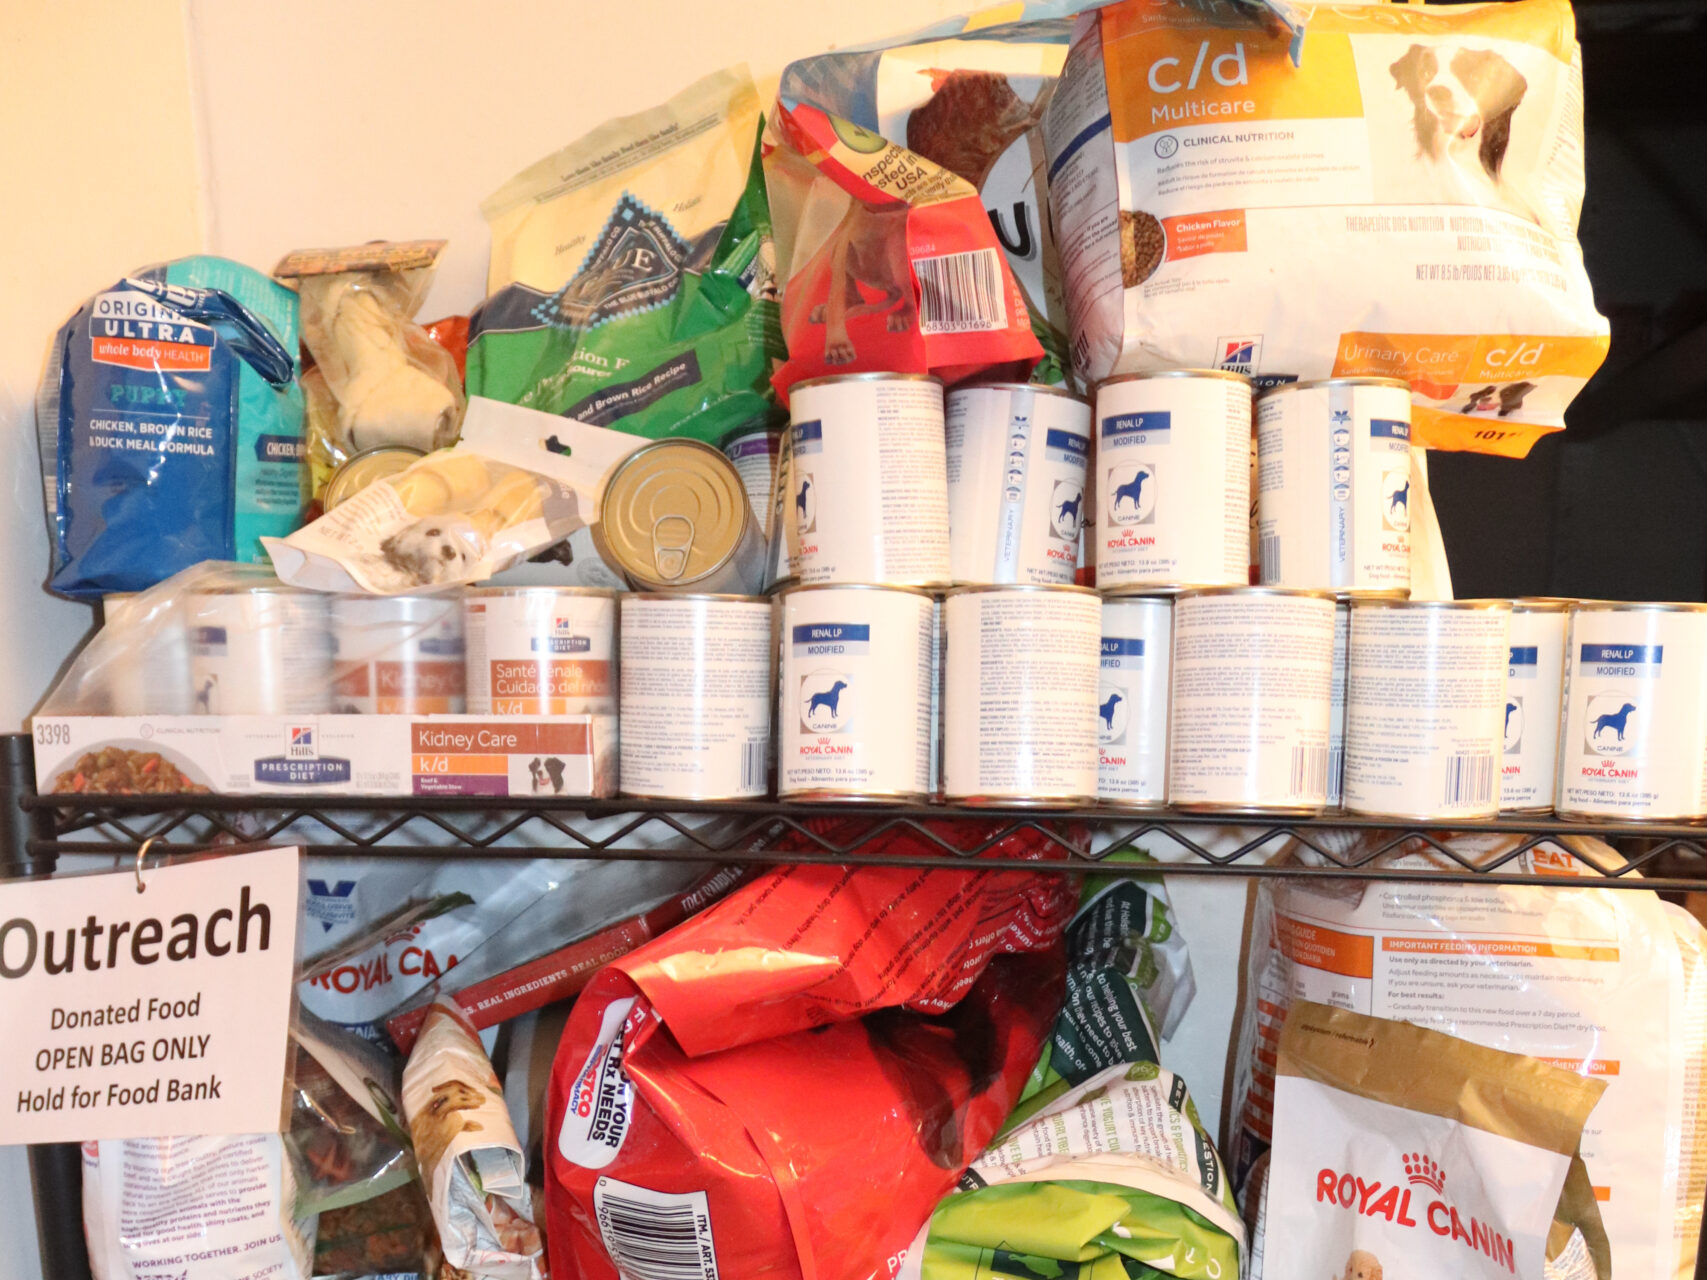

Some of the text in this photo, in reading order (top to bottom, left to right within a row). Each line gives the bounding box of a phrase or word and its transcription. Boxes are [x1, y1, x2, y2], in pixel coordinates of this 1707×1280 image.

[1147, 41, 1249, 94] c/d
[1151, 98, 1256, 125] Multicare
[1183, 132, 1294, 148] CLINICAL NUTRITION
[895, 165, 928, 190] USA
[1176, 217, 1240, 233] Chicken Flavor
[1345, 216, 1391, 232] THERAPEUTIC
[1408, 216, 1445, 232] NUTRITION
[103, 320, 195, 344] ULTRA
[98, 342, 204, 362] whole body HEALTH
[1344, 342, 1545, 366] Urinary Care c/d
[110, 383, 188, 407] PUPPY
[577, 403, 593, 422] and
[595, 390, 629, 411] Brown
[631, 381, 653, 399] Rice
[653, 360, 687, 389] Recipe
[89, 419, 213, 439] CHICKEN, BROWN RICE
[1116, 418, 1144, 429] RENAL LP
[1113, 434, 1146, 446] MODIFIED
[1117, 514, 1140, 522] CANINE
[1003, 508, 1016, 562] VETERINARY
[1107, 536, 1155, 549] ROYAL CANIN
[811, 628, 842, 638] RENAL LP
[807, 645, 845, 655] MODIFIED
[1601, 649, 1633, 659] RENAL LP
[1596, 666, 1636, 677] MODIFIED
[36, 724, 71, 745] 3398
[419, 730, 517, 750] Kidney Care
[799, 745, 854, 755] ROYAL CANIN
[261, 763, 343, 772] PRESCRIPTION
[419, 756, 449, 773] k/d
[1582, 767, 1638, 778] ROYAL CANIN
[289, 772, 314, 781] DIET
[1532, 849, 1575, 868] EAT
[0, 885, 271, 979] Outreach
[1389, 940, 1537, 953] IMPORTANT FEEDING INFORMATION
[309, 956, 393, 996] ROYAL
[572, 961, 598, 977] REAL
[477, 970, 569, 1015] REAL INGREDIENTS.
[1400, 991, 1416, 999] best
[1417, 991, 1445, 1000] results:
[51, 992, 201, 1030] Donated Food
[1102, 979, 1115, 1012] helping
[1112, 1010, 1128, 1031] your
[1121, 1029, 1138, 1052] best
[35, 1034, 211, 1072] OPEN BAG ONLY
[605, 1055, 621, 1079] Rx
[17, 1073, 223, 1114] Hold for Food Bank
[592, 1083, 616, 1141] NEEDS
[1102, 1106, 1117, 1137] YOGURT
[605, 1102, 628, 1149] YOUR
[697, 1214, 708, 1236] ITM.
[1315, 1167, 1516, 1275] ROYAL CANIN
[132, 1255, 183, 1270] WORKING
[185, 1244, 242, 1262] TOGETHER.
[244, 1238, 267, 1251] JOIN
[700, 1244, 713, 1266] ART.
[252, 1263, 283, 1280] SOCIETY
